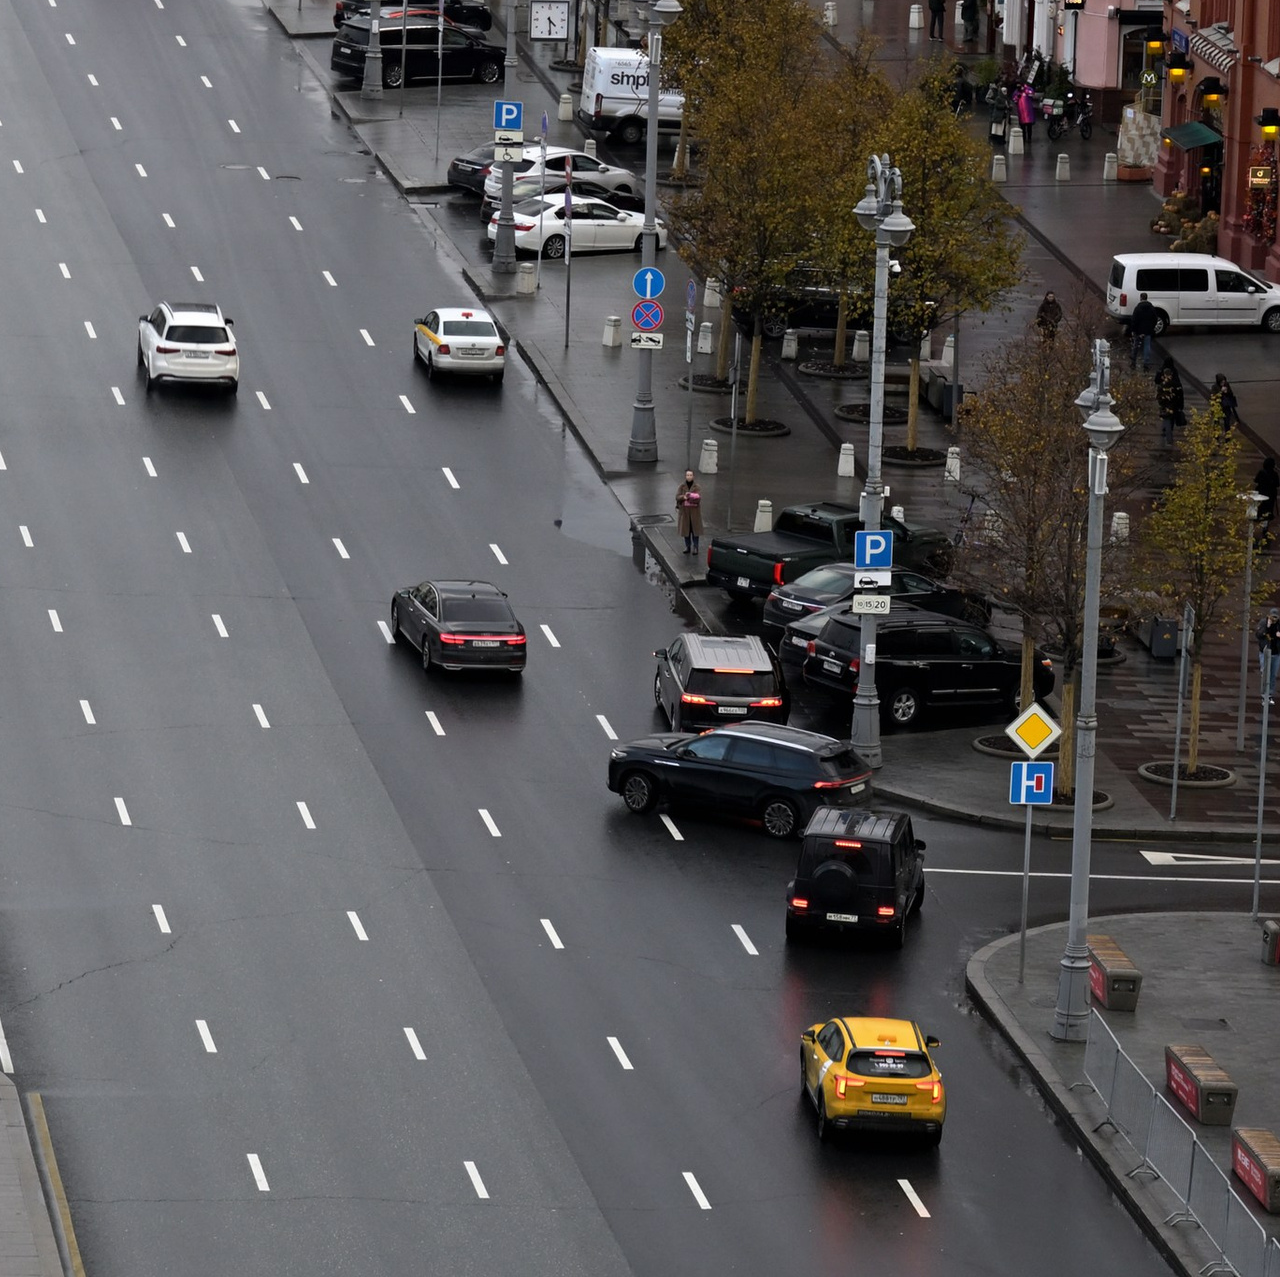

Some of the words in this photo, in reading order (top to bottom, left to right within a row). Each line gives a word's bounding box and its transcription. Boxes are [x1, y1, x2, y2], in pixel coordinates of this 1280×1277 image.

[502, 104, 518, 126] P
[865, 535, 886, 564] P
[865, 600, 872, 608] 15
[874, 600, 886, 609] 20
